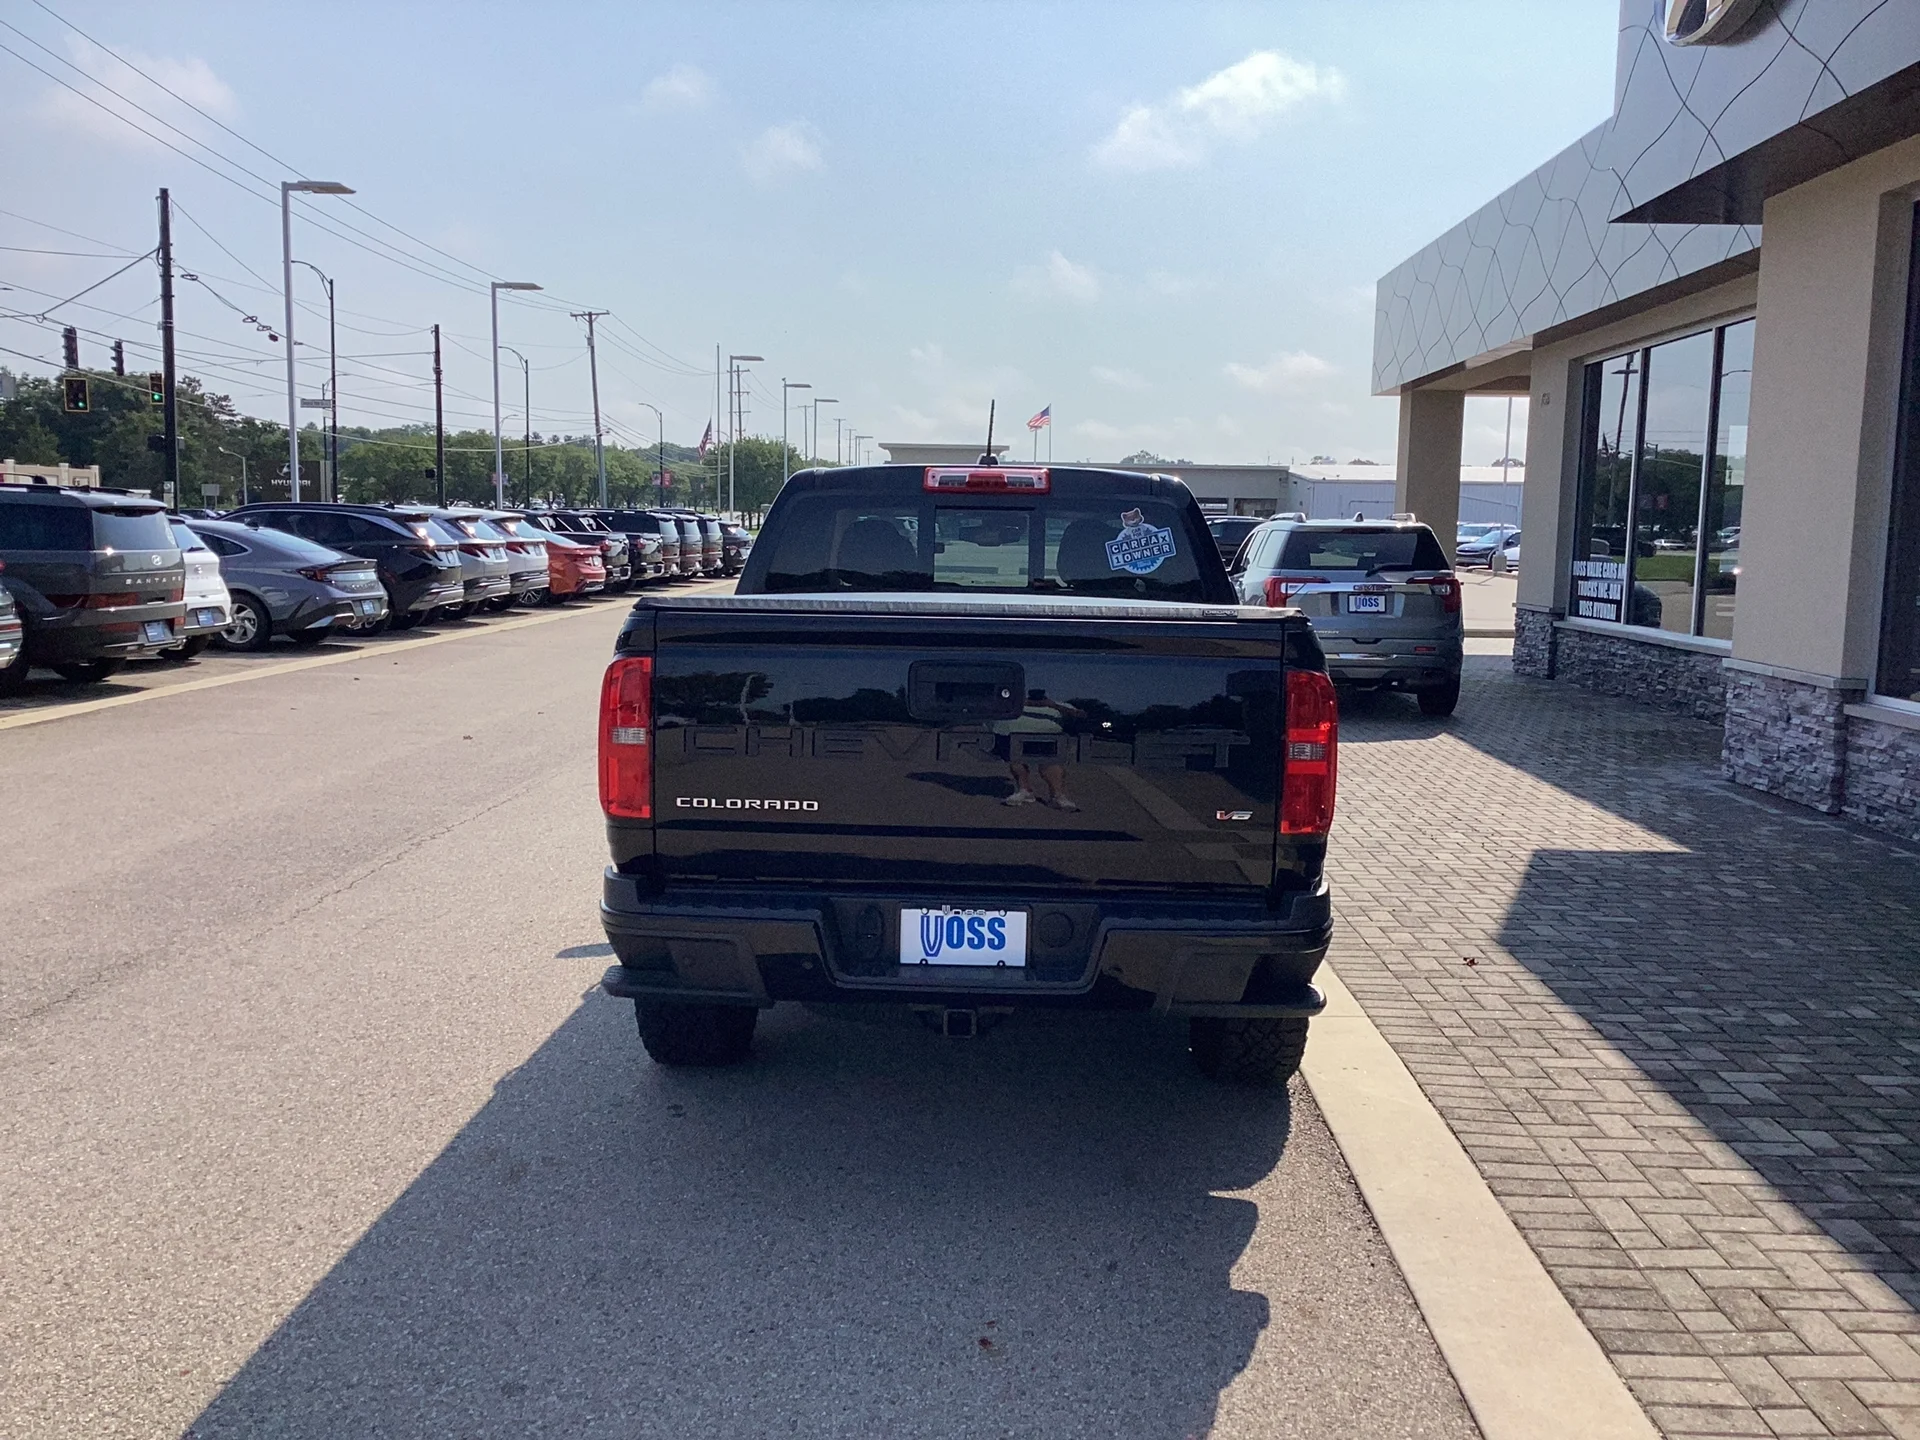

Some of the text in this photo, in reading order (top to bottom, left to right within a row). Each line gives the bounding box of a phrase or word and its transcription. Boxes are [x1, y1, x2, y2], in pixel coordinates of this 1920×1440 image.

[271, 479, 311, 487] HYUDAI
[1112, 535, 1168, 553] CARFAX
[126, 577, 167, 585] SANTA
[1355, 596, 1379, 610] VOSS
[683, 725, 1249, 768] CHEVROLET
[676, 797, 819, 811] COLORADO
[1216, 810, 1253, 820] V6
[921, 915, 1006, 957] VOSS
